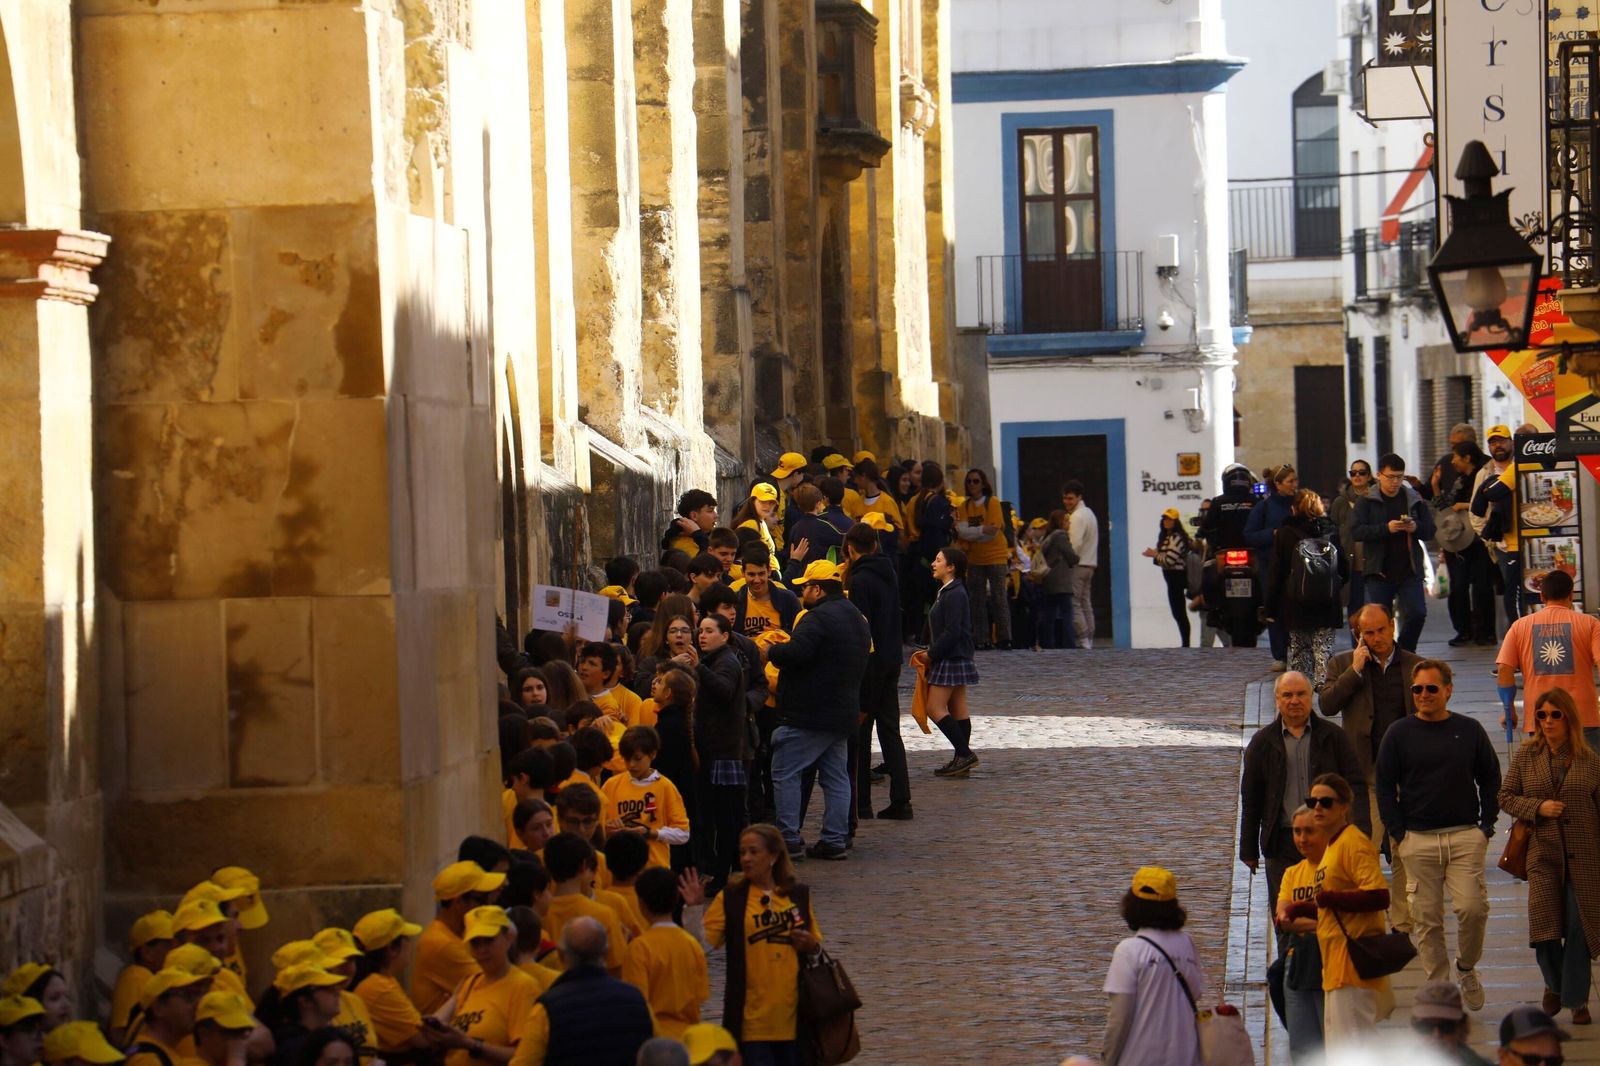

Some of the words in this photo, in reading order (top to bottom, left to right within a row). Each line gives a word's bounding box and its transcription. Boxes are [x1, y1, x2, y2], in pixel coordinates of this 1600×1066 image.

[1534, 301, 1560, 316] eing
[1142, 479, 1202, 495] Piquera
[743, 616, 771, 628] ODOS
[617, 799, 646, 815] TODO
[1292, 886, 1314, 902] TOD
